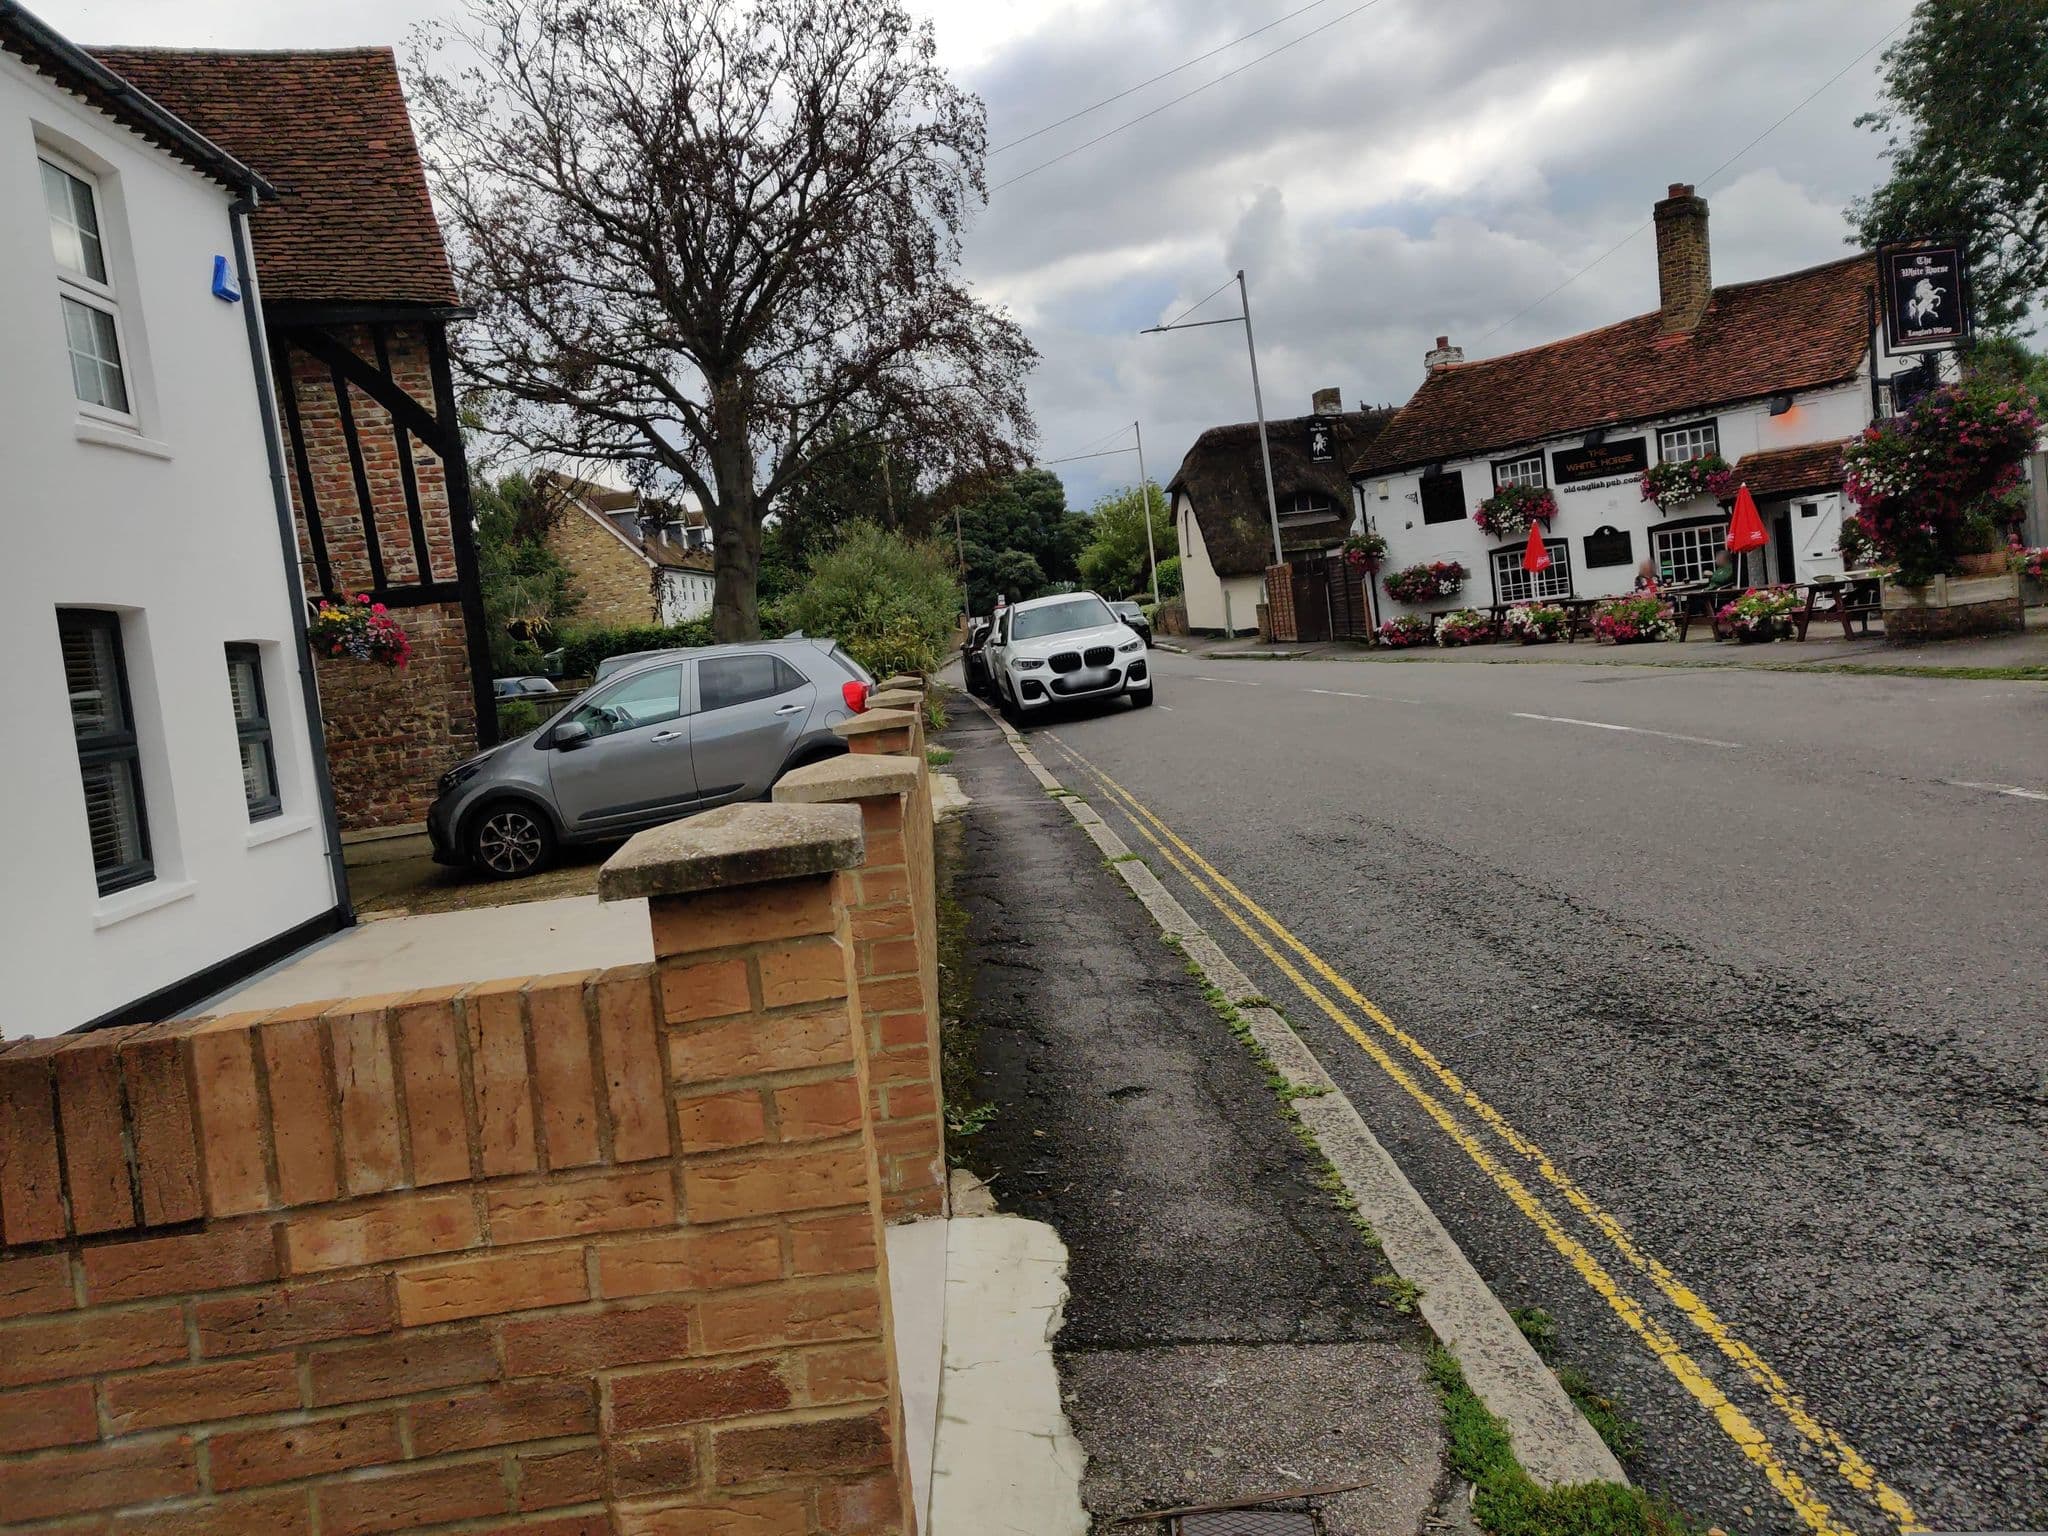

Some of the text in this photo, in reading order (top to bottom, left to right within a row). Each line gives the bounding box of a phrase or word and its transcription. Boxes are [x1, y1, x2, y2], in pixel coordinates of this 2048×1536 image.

[1916, 256, 1932, 265] The
[1901, 265, 1949, 277] White Horse
[1588, 447, 1607, 457] THE
[1566, 460, 1598, 472] WHITE
[1600, 453, 1634, 466] HORSE
